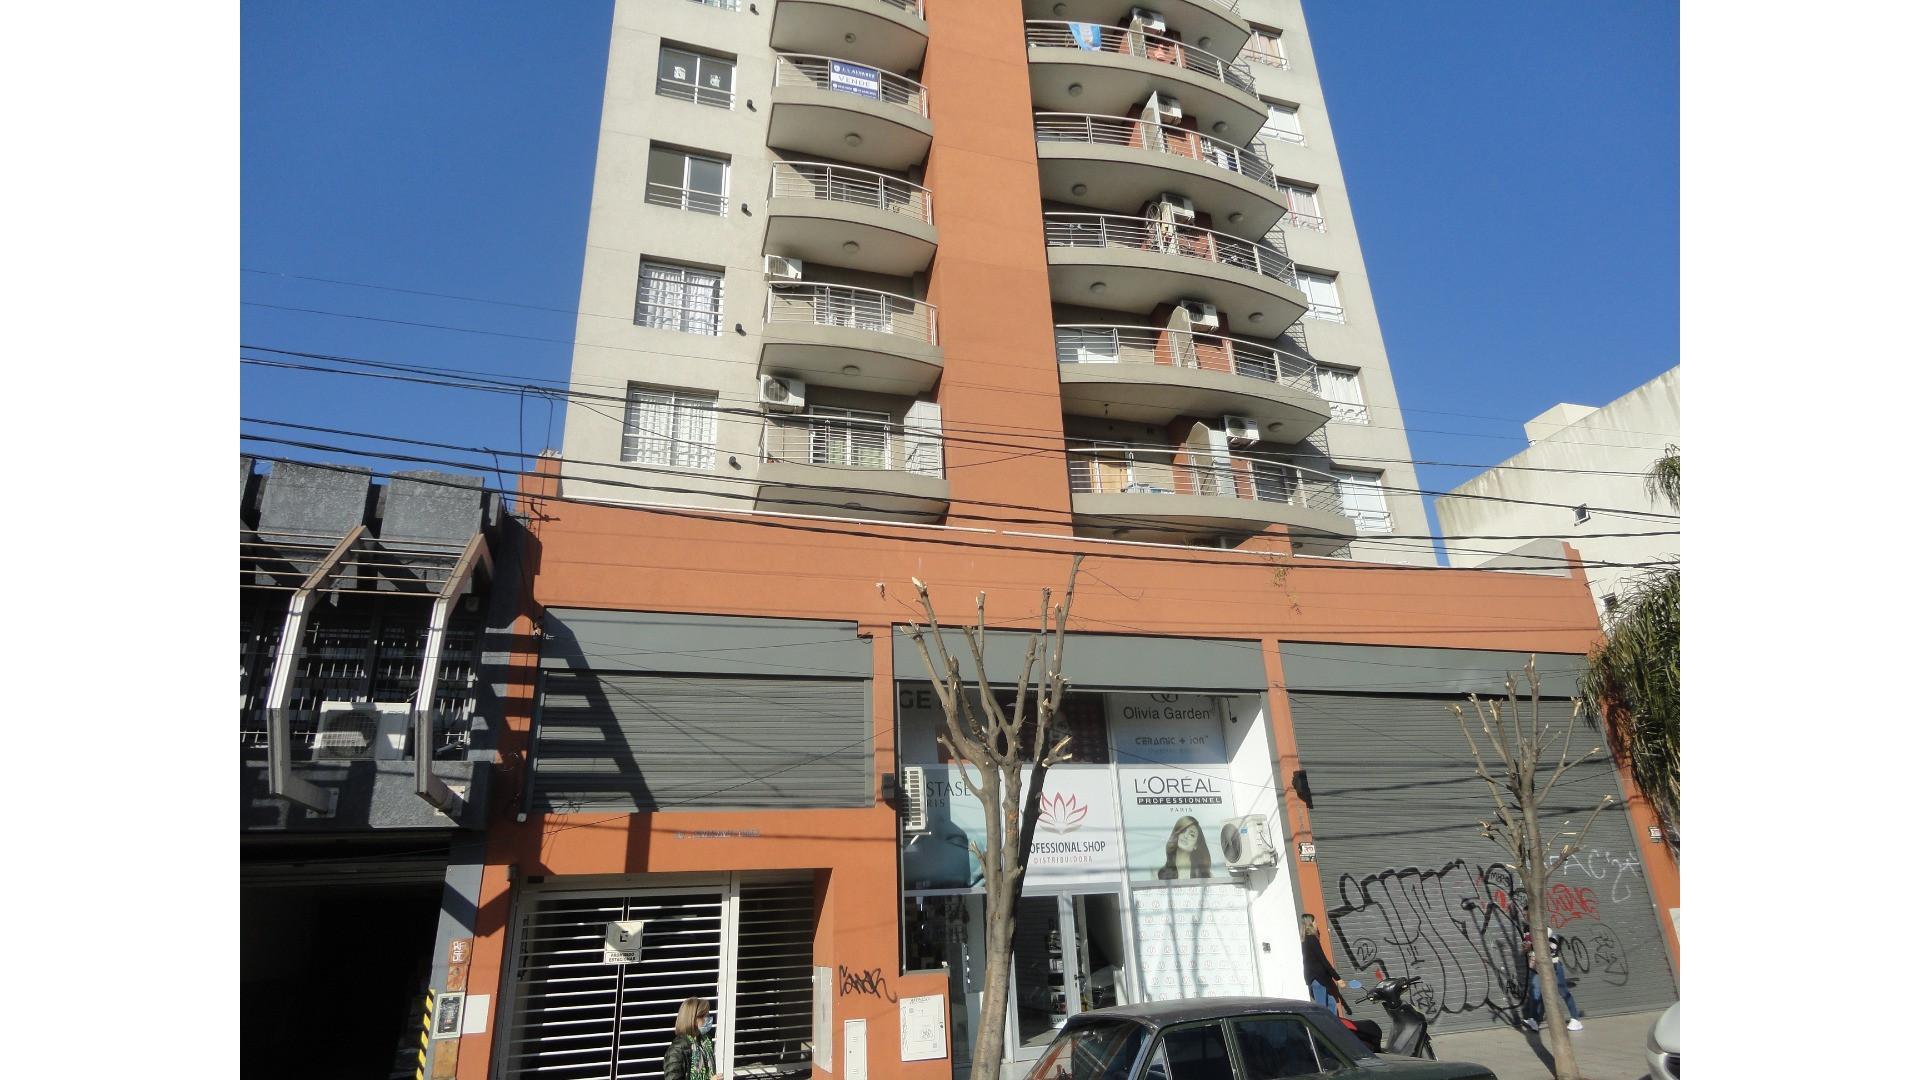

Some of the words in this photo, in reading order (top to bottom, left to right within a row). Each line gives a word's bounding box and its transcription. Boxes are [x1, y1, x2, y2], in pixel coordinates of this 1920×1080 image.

[1123, 706, 1160, 719] Olivia
[1164, 706, 1210, 720] Garden
[927, 782, 972, 797] STASE
[1134, 776, 1221, 794] L'ORÉAL
[1138, 797, 1221, 805] PROFESSIONNEL
[1030, 842, 1082, 854] OFESSIONAL
[1083, 840, 1106, 852] SHOP
